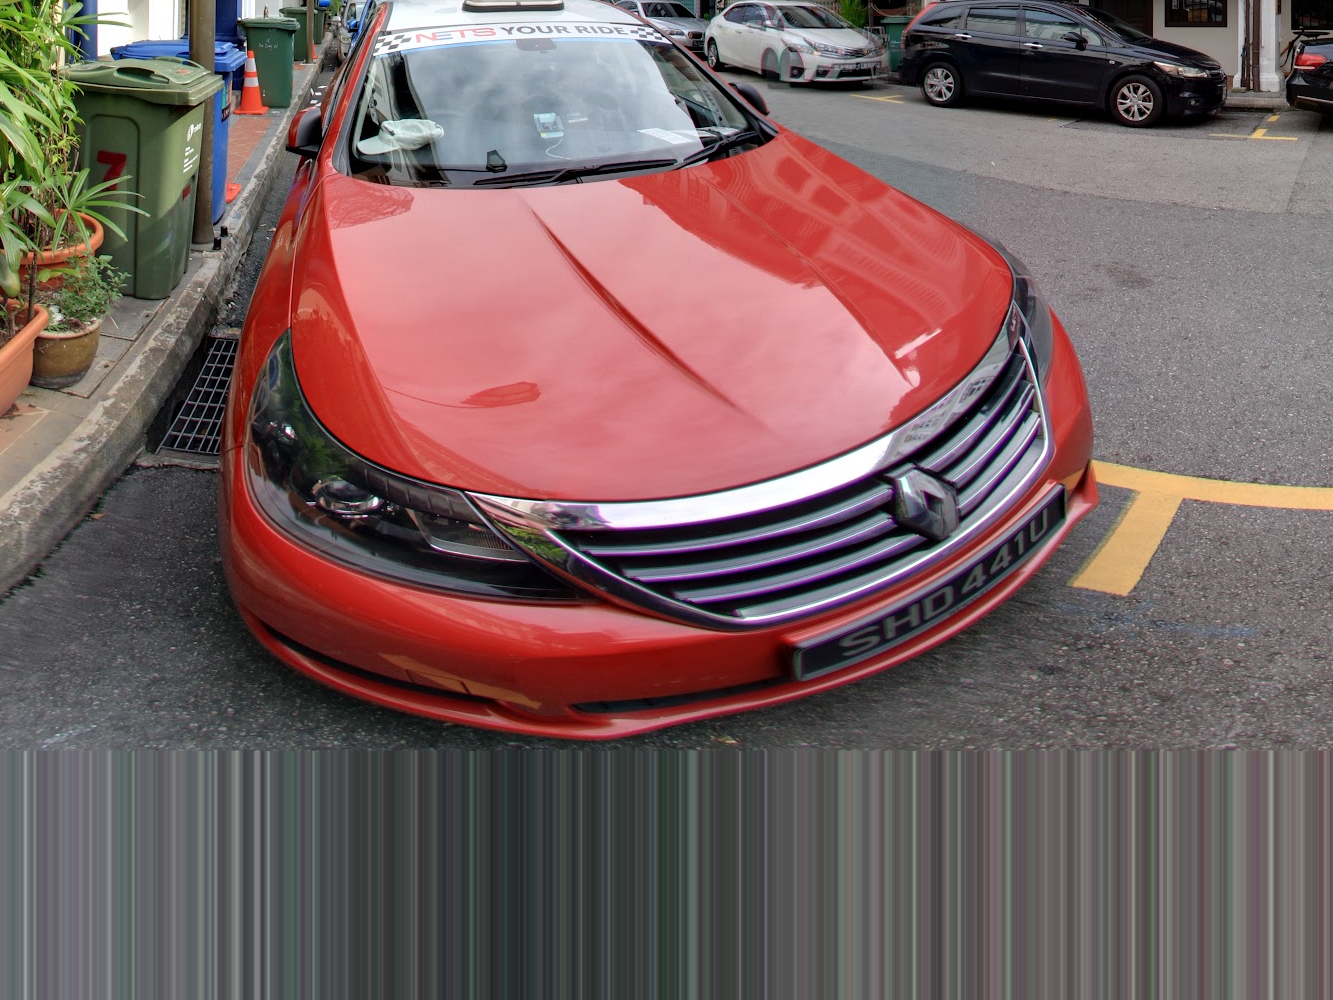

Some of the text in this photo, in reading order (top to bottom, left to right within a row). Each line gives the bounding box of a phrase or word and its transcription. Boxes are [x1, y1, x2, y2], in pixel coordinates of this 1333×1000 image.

[415, 25, 629, 43] NETS YOUR RIDE
